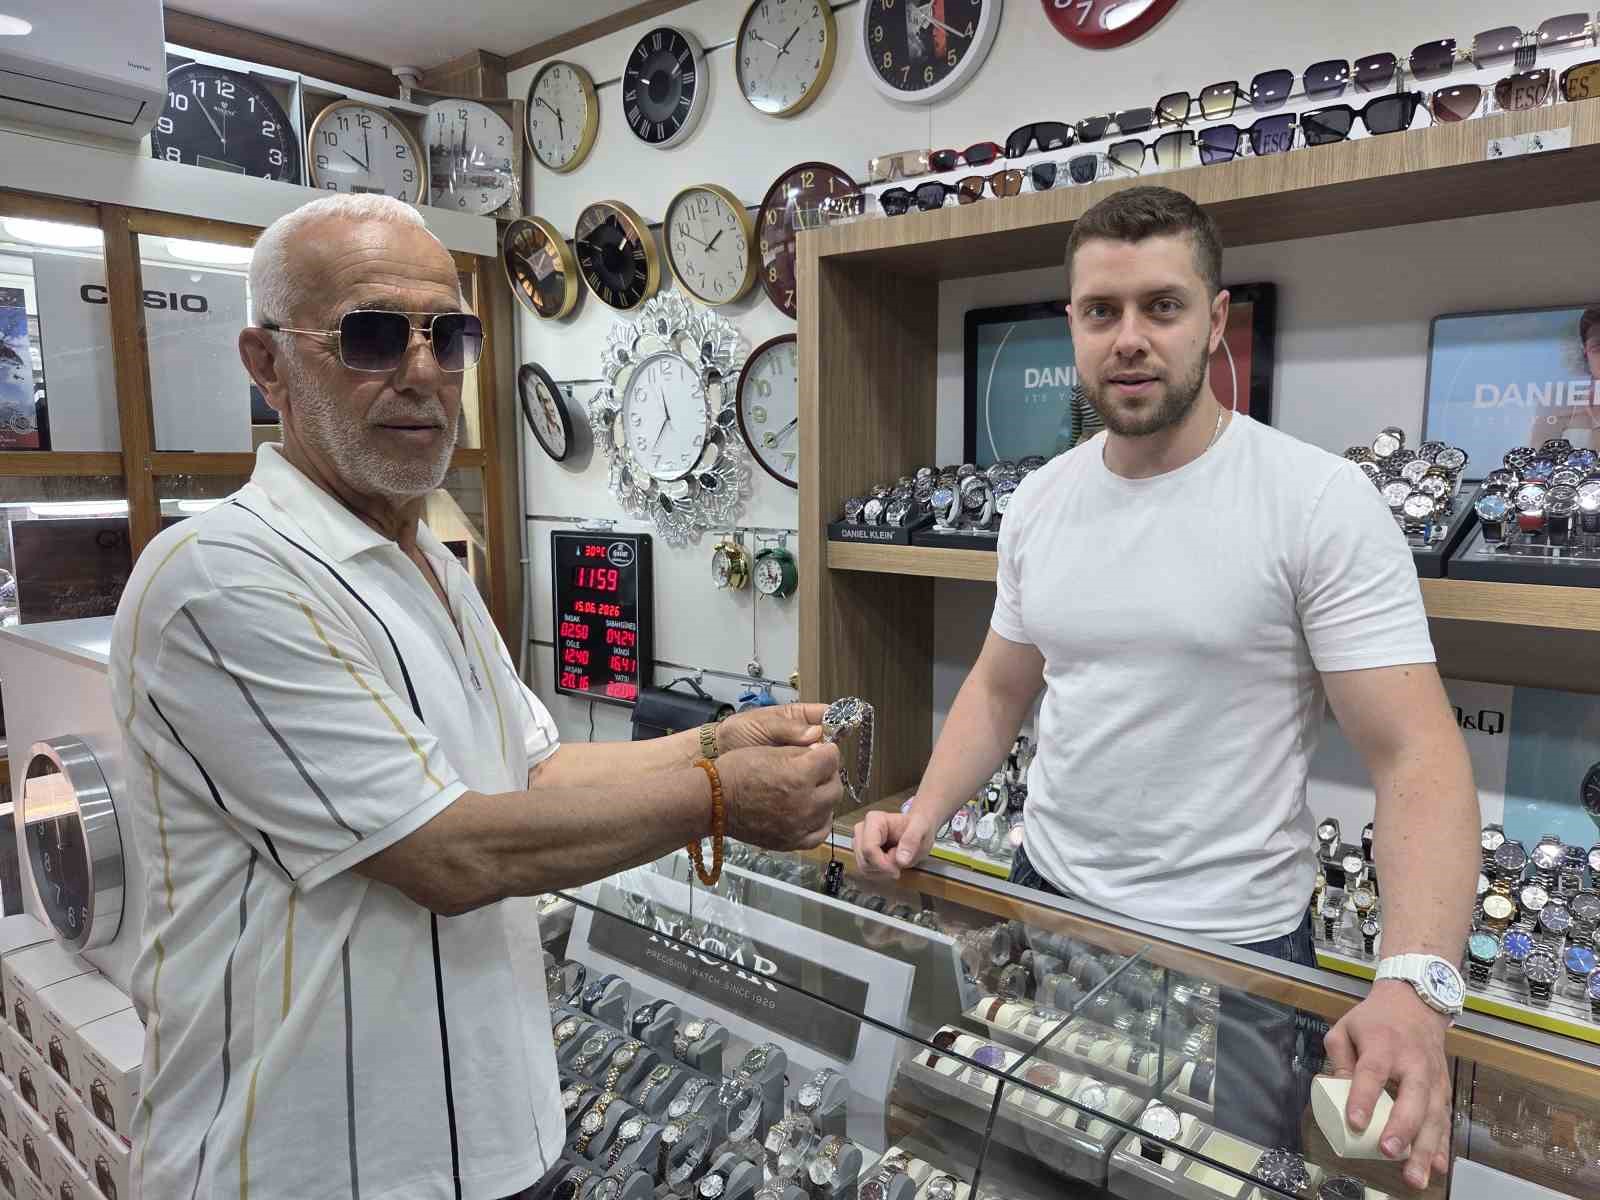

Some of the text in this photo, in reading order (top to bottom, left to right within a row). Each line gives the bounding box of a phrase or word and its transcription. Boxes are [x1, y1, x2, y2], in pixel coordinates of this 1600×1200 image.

[1076, 0, 1093, 26] 7
[874, 25, 884, 42] 9
[964, 20, 975, 38] 4
[883, 52, 893, 69] 8
[947, 49, 958, 66] 5
[901, 65, 911, 83] 7
[924, 66, 934, 83] 6
[190, 79, 205, 98] 11
[214, 79, 235, 99] 12
[168, 91, 188, 111] 10
[248, 97, 255, 113] 1
[157, 116, 173, 134] 9
[262, 120, 276, 138] 2
[337, 116, 349, 131] 11
[356, 113, 371, 129] 12
[322, 130, 338, 146] 10
[382, 125, 388, 140] 1
[497, 136, 505, 146] 2
[165, 146, 181, 162] 8
[268, 148, 283, 166] 3
[395, 144, 407, 159] 2
[316, 154, 329, 169] 9
[402, 168, 413, 183] 3
[800, 171, 815, 188] 12
[828, 177, 834, 193] 1
[684, 204, 696, 221] 11
[696, 197, 709, 214] 12
[715, 200, 721, 217] 1
[726, 213, 738, 231] 2
[765, 210, 777, 225] 10
[677, 241, 687, 257] 9
[760, 240, 769, 257] 9
[686, 258, 696, 277] 8
[768, 266, 777, 283] 8
[699, 272, 705, 289] 7
[728, 271, 737, 287] 5
[80, 285, 208, 313] CSIO
[784, 290, 794, 309] 7
[751, 404, 768, 424] 9
[841, 528, 893, 540] DANIEL KLEIN
[55, 883, 61, 904] 7
[68, 906, 76, 929] 6
[646, 948, 688, 971] PRECISION
[689, 967, 720, 985] WATCH
[723, 981, 752, 999] SINCE
